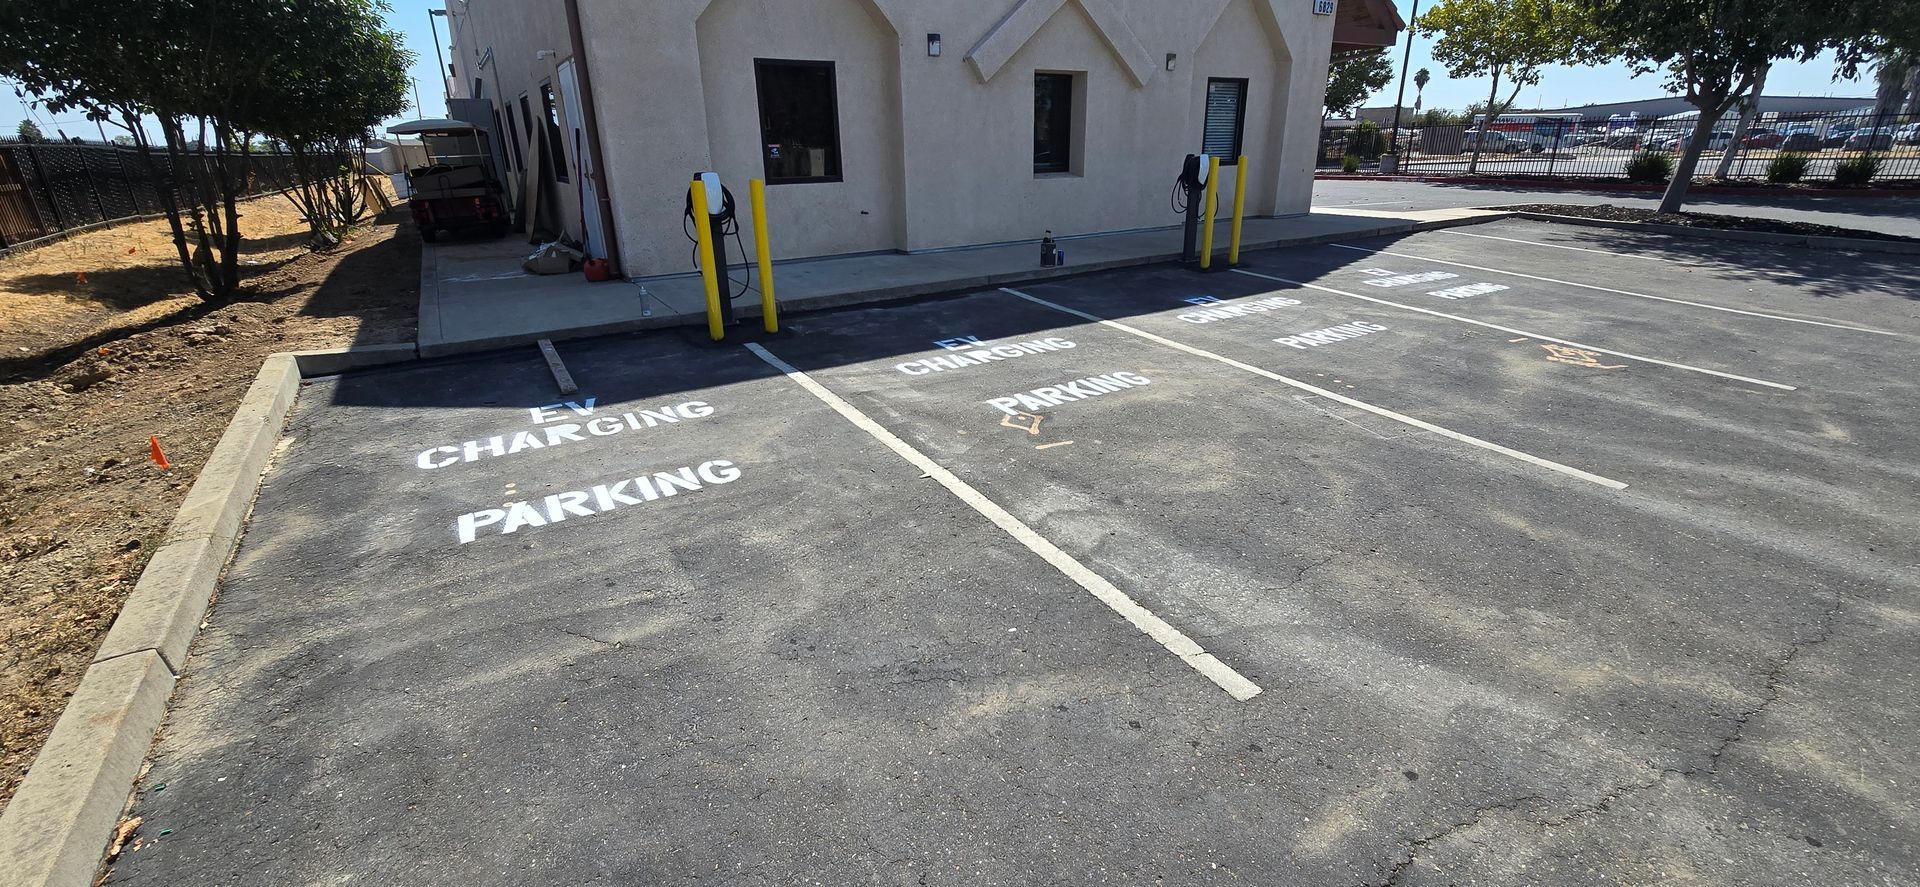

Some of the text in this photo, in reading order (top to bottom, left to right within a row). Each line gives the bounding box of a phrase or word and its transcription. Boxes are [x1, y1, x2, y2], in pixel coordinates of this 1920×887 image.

[1176, 297, 1302, 324] CHARGING
[934, 335, 988, 351] EV
[1272, 320, 1388, 350] PARKING
[896, 337, 1077, 375] CHARGING
[986, 371, 1151, 416] PARKING
[529, 398, 597, 425] EV
[416, 401, 715, 470] CHARGING
[456, 460, 742, 545] PARKING
